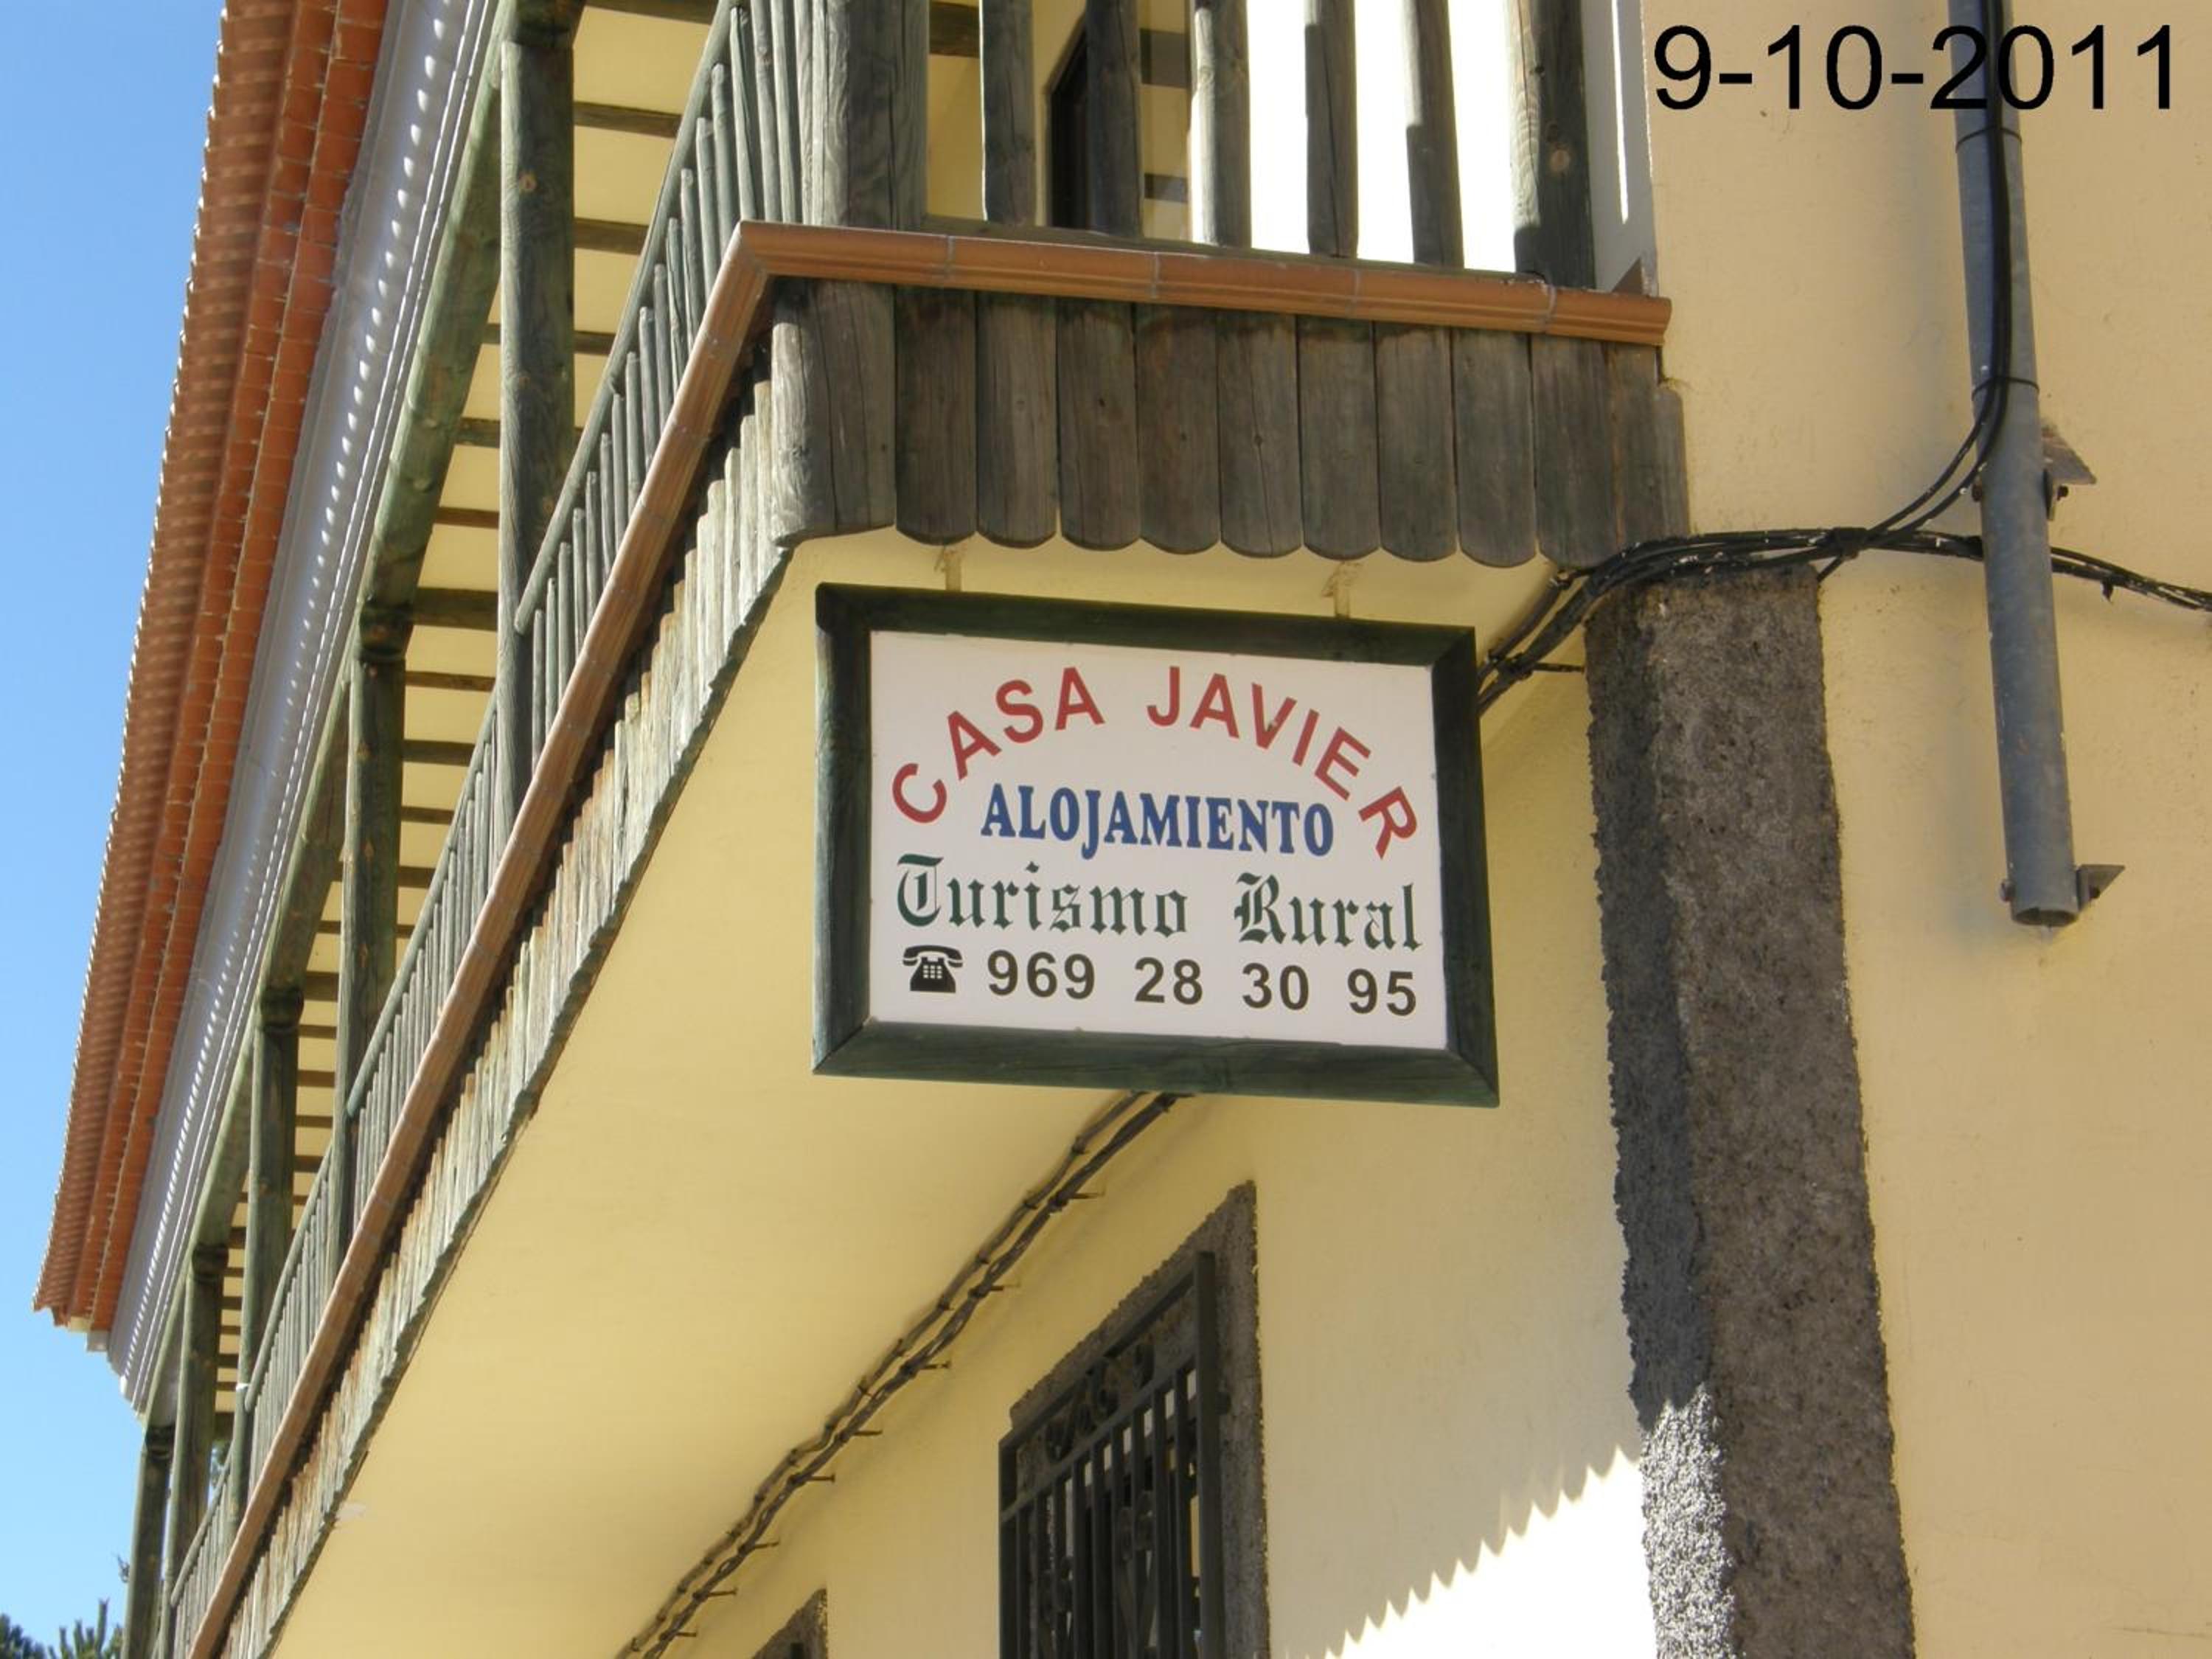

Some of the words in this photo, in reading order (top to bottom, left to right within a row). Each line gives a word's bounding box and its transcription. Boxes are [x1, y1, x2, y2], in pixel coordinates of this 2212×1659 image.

[891, 667, 1105, 824] CASA
[1147, 666, 1419, 860] JAVIER
[981, 783, 1335, 860] ALOJAMIENTO
[896, 853, 1189, 939] Turismo
[1234, 872, 1423, 953] Rural
[987, 950, 1096, 1000] 969
[1134, 958, 1204, 1005] 28
[1242, 962, 1310, 1011] 30
[1347, 969, 1417, 1016] 95
